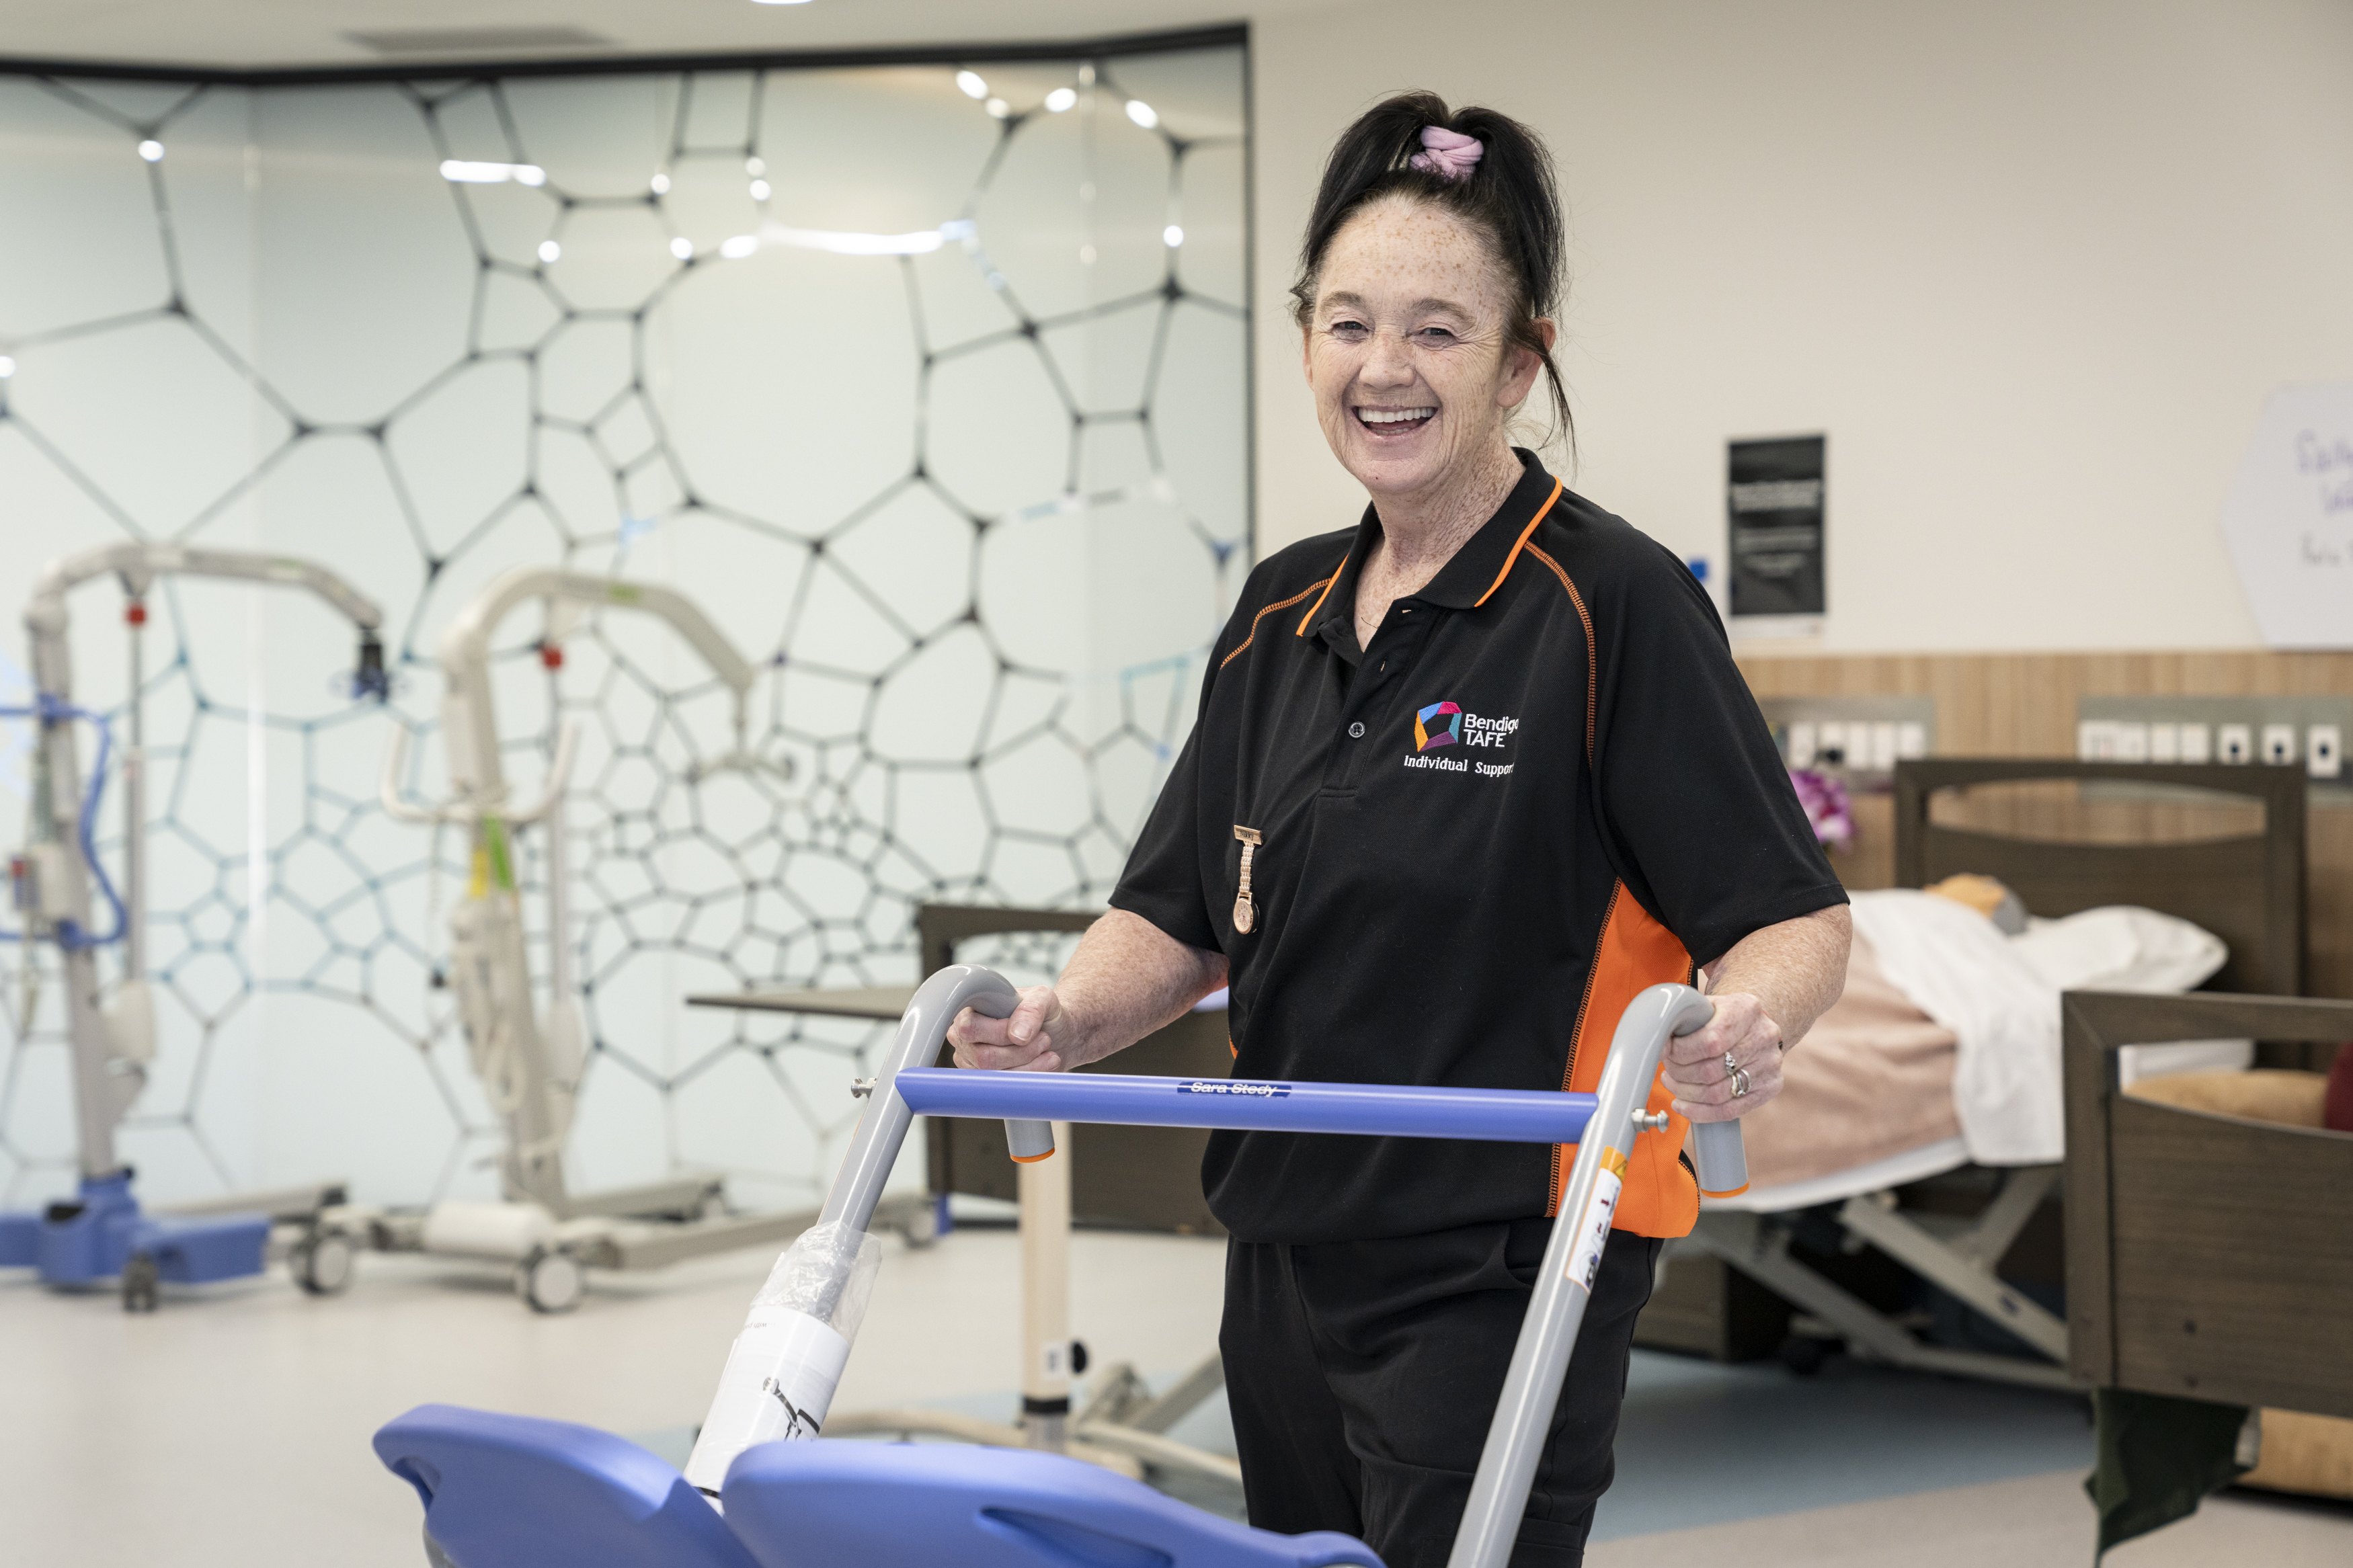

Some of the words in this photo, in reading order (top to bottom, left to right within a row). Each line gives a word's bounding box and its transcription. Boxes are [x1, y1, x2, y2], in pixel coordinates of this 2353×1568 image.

[1464, 713, 1519, 734] Bendigo
[1464, 729, 1507, 747] TAFE
[1404, 755, 1468, 772] Individual
[1191, 1081, 1227, 1094] Sara
[1231, 1083, 1277, 1098] Stedy
